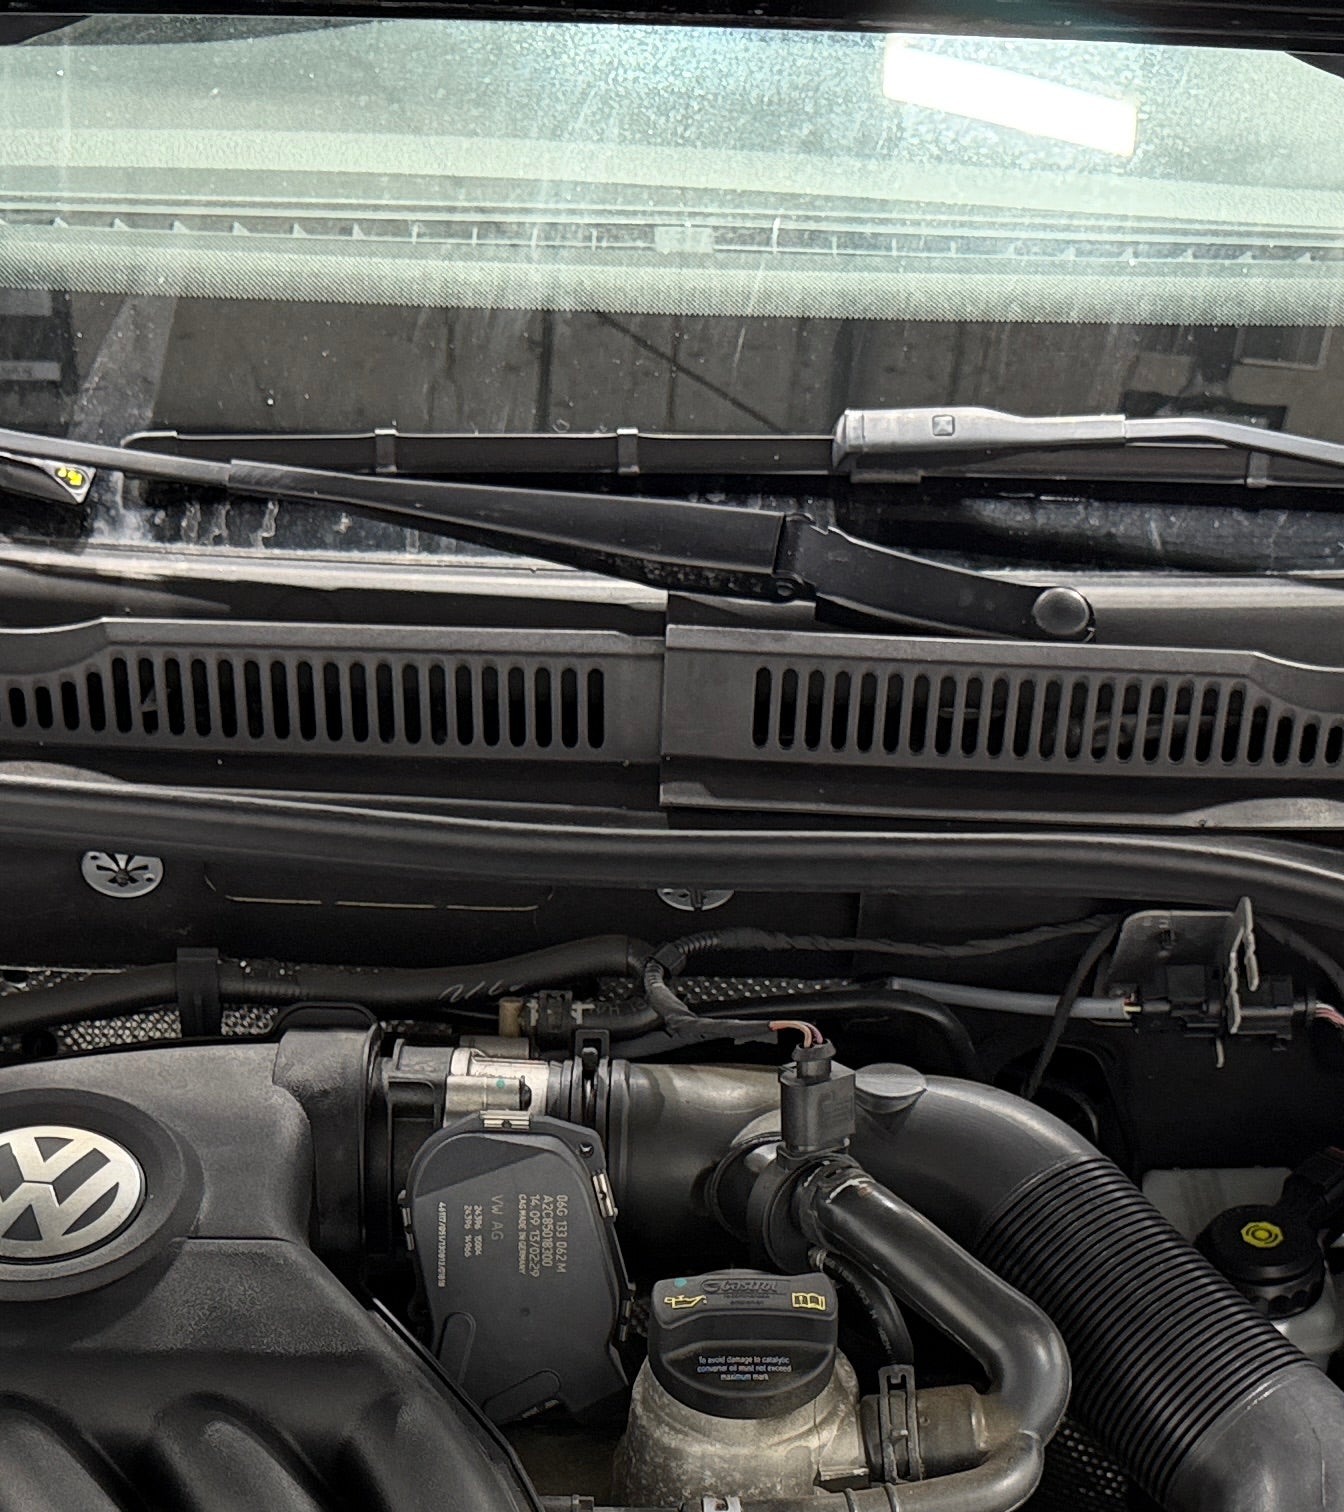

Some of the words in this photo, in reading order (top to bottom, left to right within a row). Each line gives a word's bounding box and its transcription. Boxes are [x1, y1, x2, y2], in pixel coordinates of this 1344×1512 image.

[491, 1194, 504, 1215] VW
[556, 1194, 568, 1217] 06G
[518, 1210, 527, 1230] MADE
[556, 1221, 567, 1237] 133
[491, 1221, 504, 1240] AG
